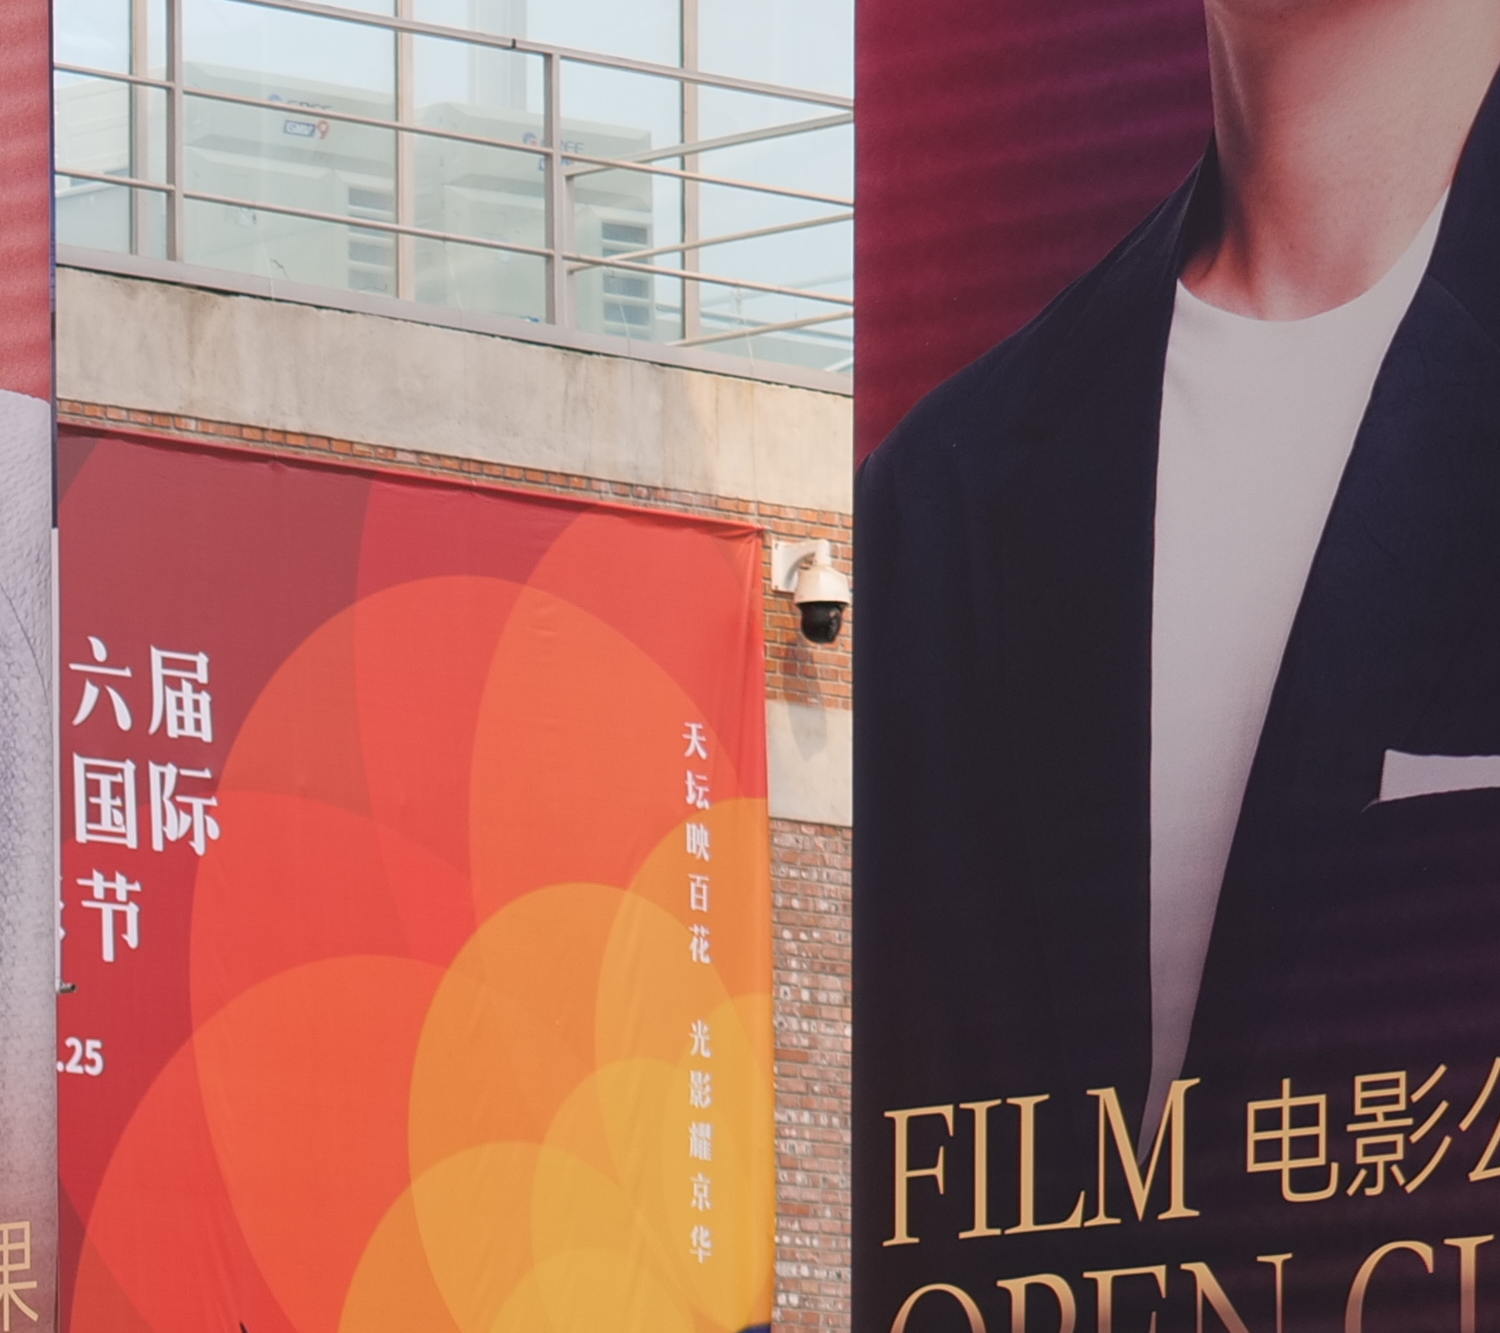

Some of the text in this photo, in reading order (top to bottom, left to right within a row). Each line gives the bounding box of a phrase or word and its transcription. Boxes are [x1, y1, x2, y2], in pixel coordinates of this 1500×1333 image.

[69, 636, 215, 744] 六届
[72, 753, 220, 857] 国际
[58, 869, 142, 963] 节
[682, 721, 713, 1264] 天坛映百花 光影耀京华
[883, 1078, 1201, 1247] FILM
